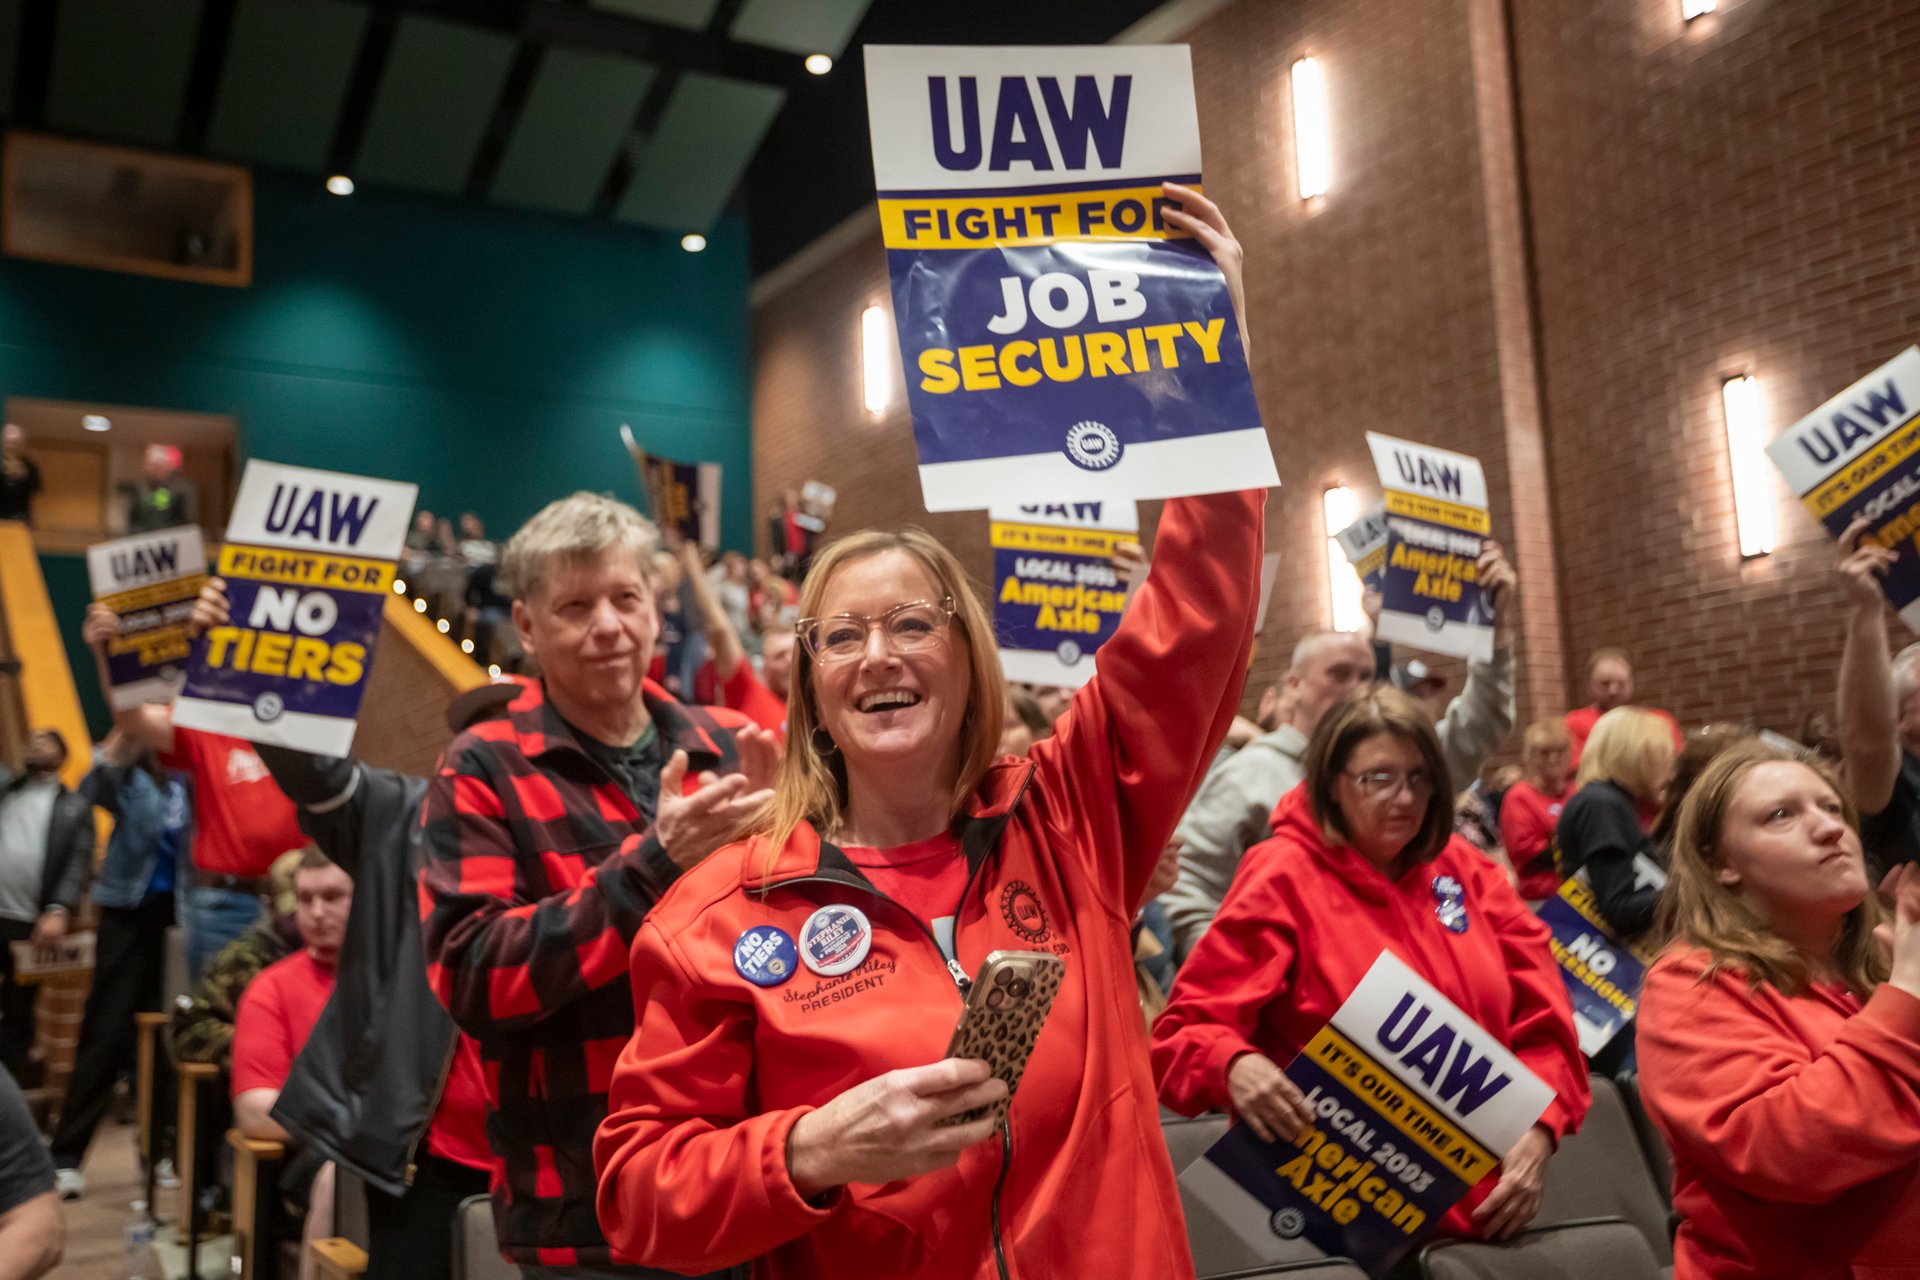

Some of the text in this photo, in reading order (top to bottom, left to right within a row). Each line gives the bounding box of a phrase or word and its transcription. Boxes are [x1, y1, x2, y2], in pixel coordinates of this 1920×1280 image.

[928, 74, 1133, 171] UAW
[903, 204, 1060, 240] FIGHT
[987, 270, 1147, 335] JOB
[918, 318, 1226, 394] SECURITY
[1797, 378, 1908, 468] UAW
[1394, 450, 1462, 497] UAW
[1851, 453, 1887, 484] OUR
[1889, 428, 1920, 456] TIM
[265, 483, 379, 546] UAW
[111, 543, 179, 581] UAW
[231, 553, 381, 585] FIGHT FOR
[1015, 556, 1074, 582] LOCAL
[1390, 542, 1480, 582] America
[1413, 569, 1463, 603] Axle
[249, 585, 339, 636] NO
[1035, 603, 1101, 634] Axle
[206, 626, 366, 686] TIERS
[740, 932, 763, 958] NO
[743, 931, 783, 974] TIERS
[806, 912, 854, 948] STEPHANIE
[820, 926, 845, 946] RILEY
[1567, 932, 1617, 976] NO
[801, 975, 885, 1014] PRESIDENT
[1376, 990, 1514, 1119] UAW
[1320, 1041, 1480, 1173] IT'S OUR TIME AT
[1303, 1085, 1436, 1193] LOCAL 2093
[1275, 1152, 1361, 1226] Axle
[1295, 1124, 1427, 1236] merican
